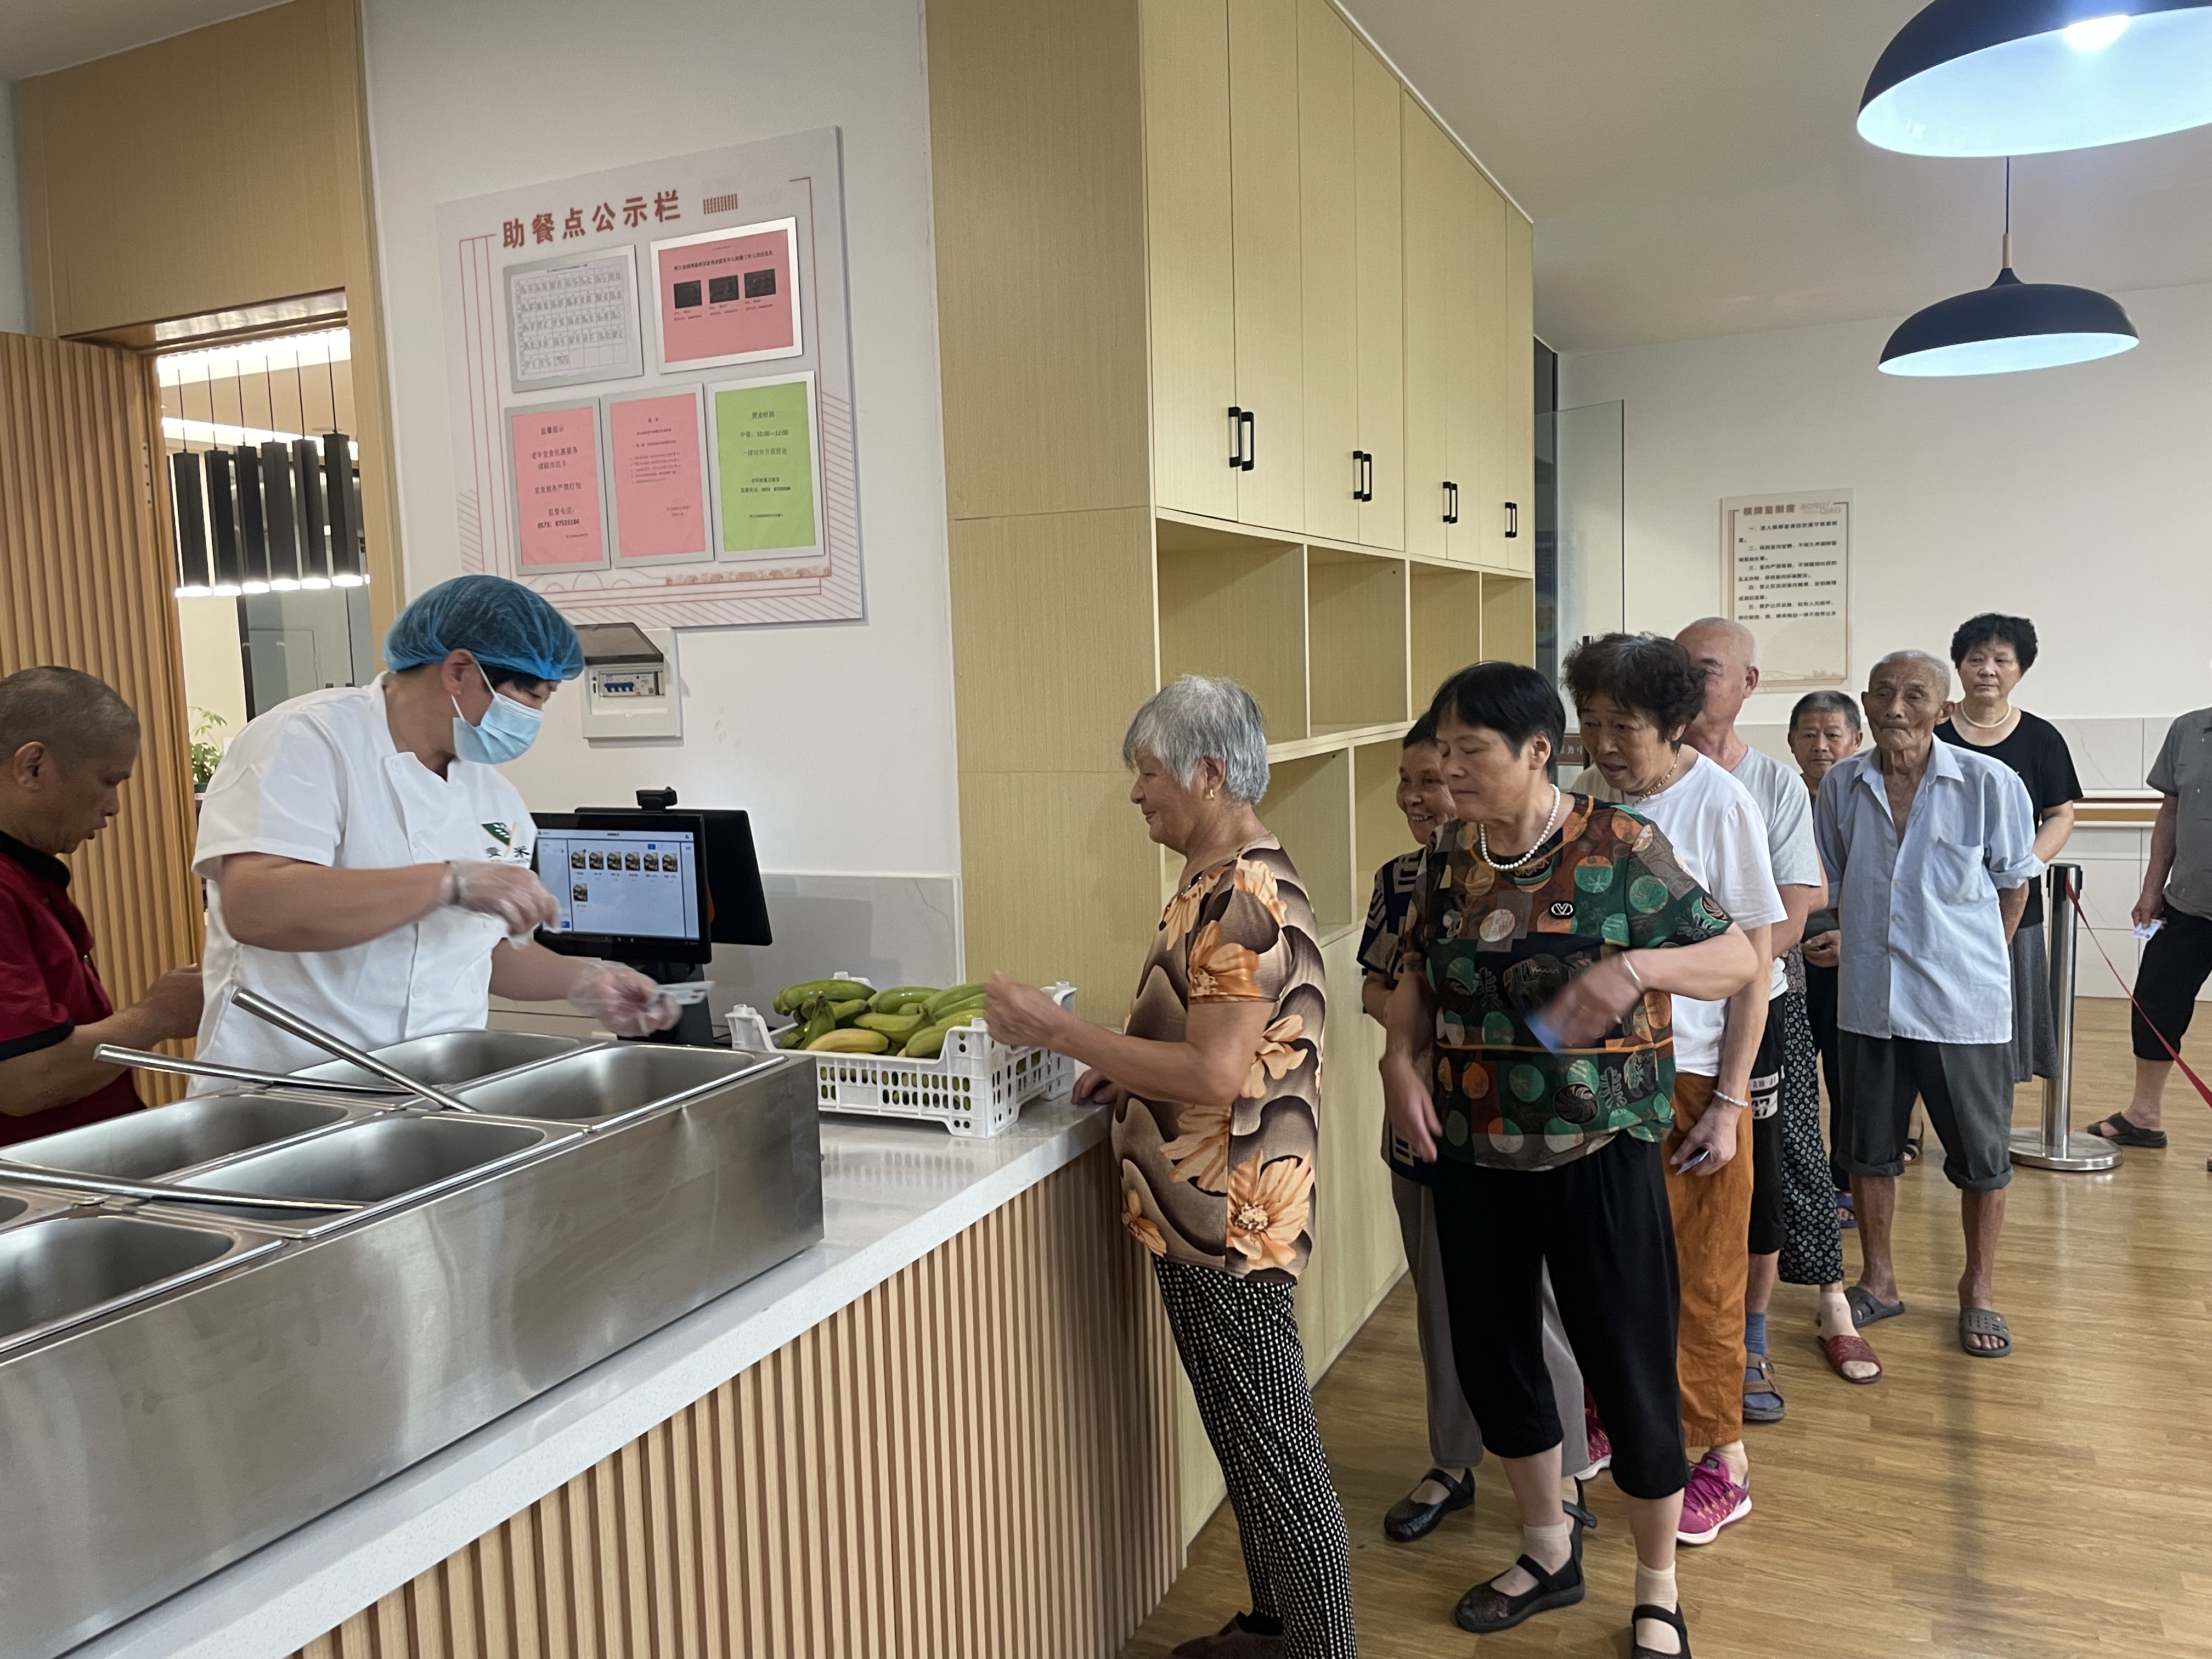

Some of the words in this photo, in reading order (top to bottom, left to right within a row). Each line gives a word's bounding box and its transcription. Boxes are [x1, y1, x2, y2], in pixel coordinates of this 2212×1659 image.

[503, 190, 680, 249] 助餐点公示栏
[752, 411, 775, 419] 营业时间
[541, 425, 564, 435] 温馨提示
